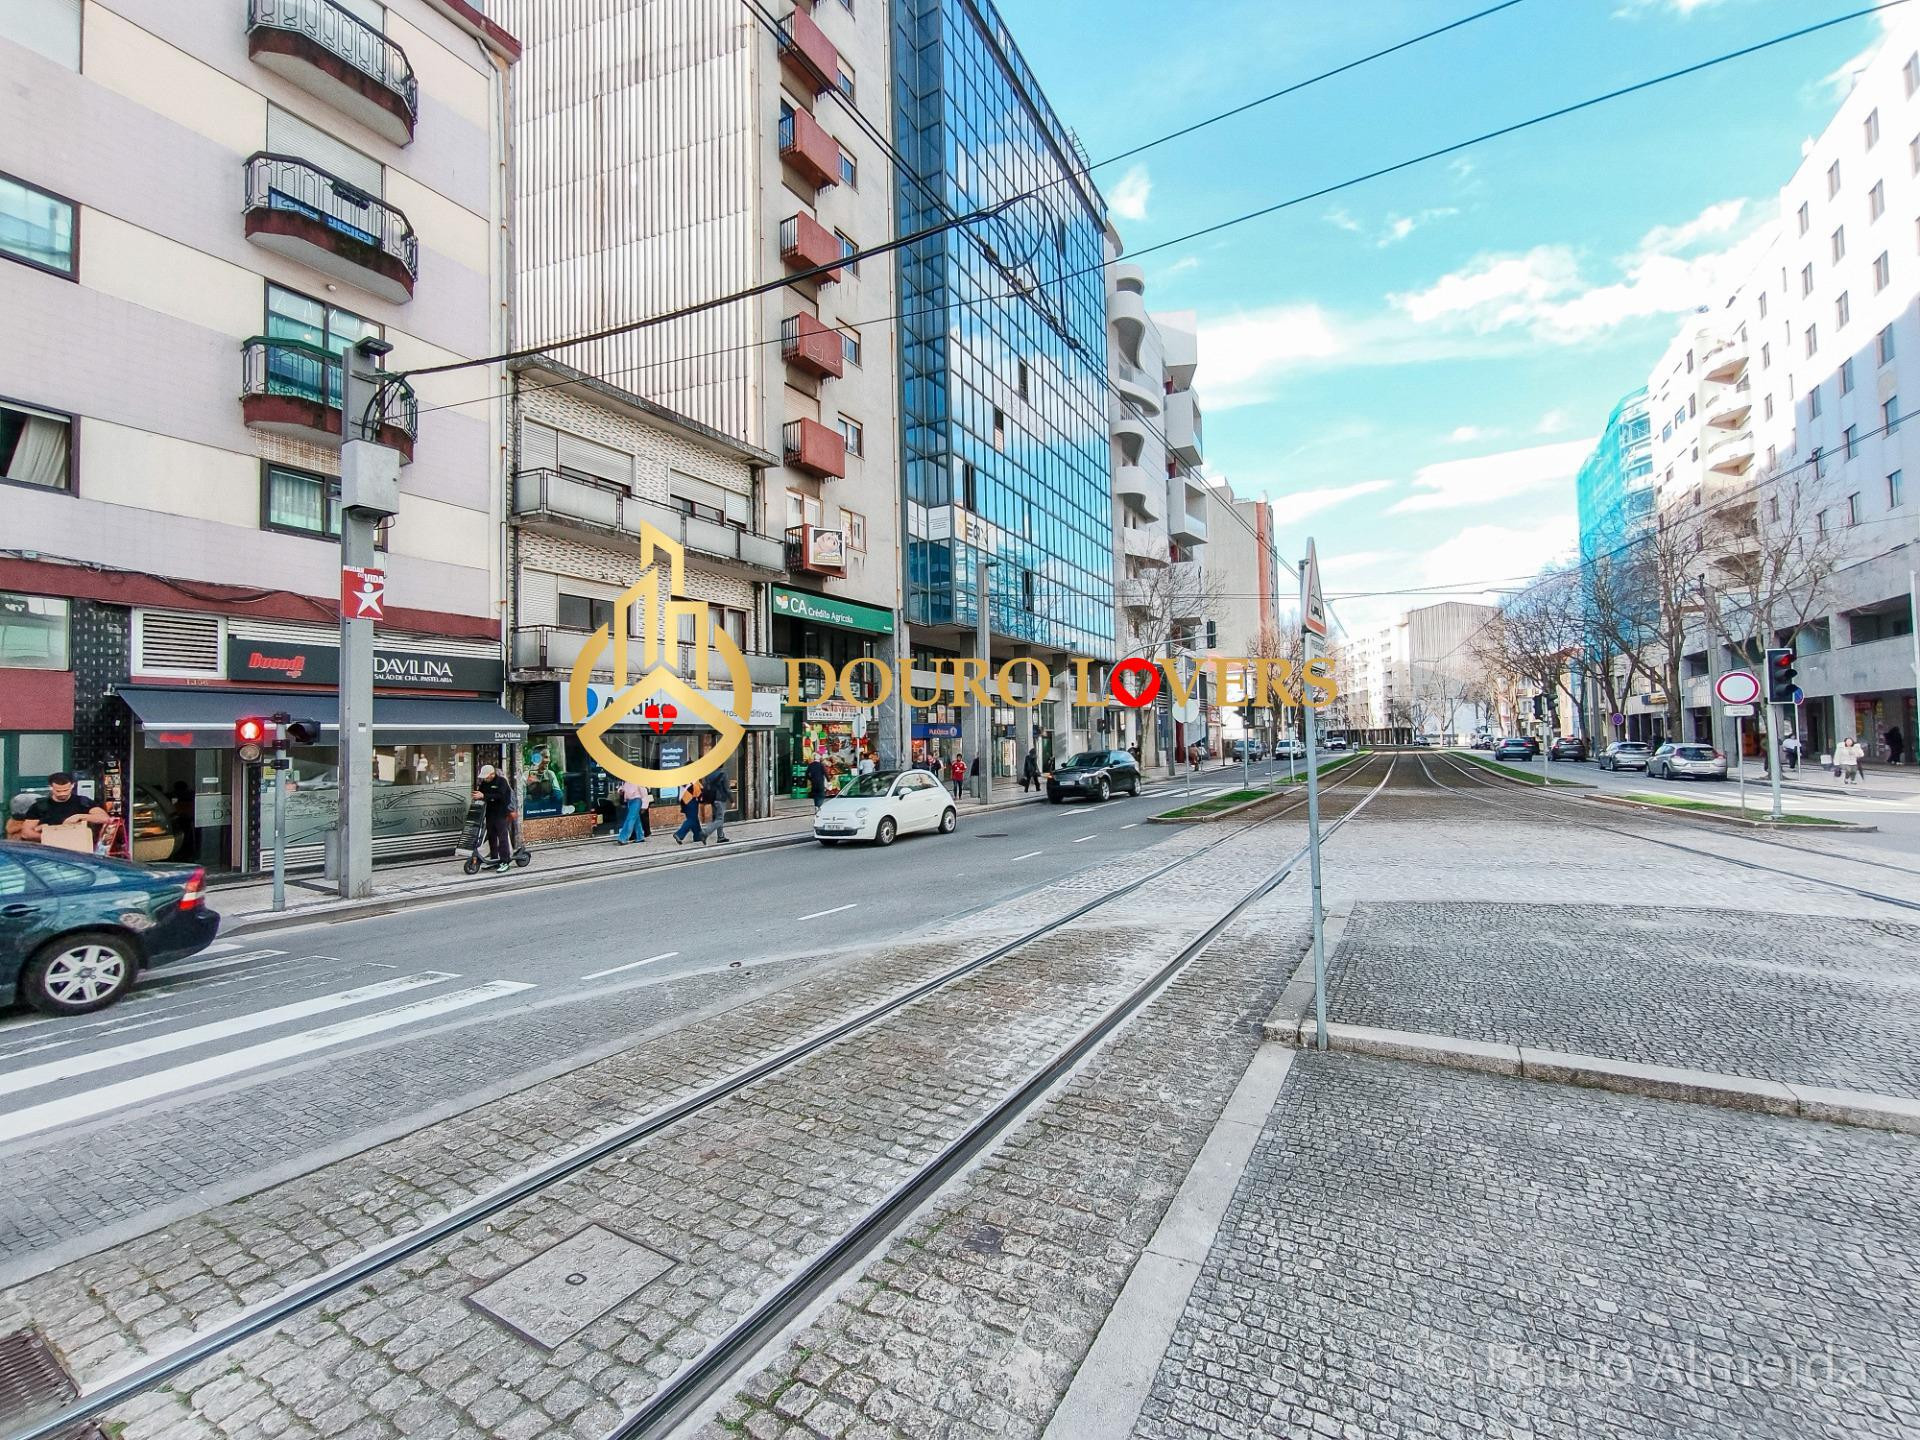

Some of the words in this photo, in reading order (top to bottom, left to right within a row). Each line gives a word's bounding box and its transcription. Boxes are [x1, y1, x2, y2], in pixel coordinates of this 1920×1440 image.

[364, 573, 384, 584] VIDA
[790, 598, 808, 615] CA
[808, 607, 830, 620] Crédito
[373, 657, 454, 677] DAVILINA
[420, 676, 453, 684] PASTELARIA
[494, 731, 521, 739] Davilina
[420, 815, 465, 829] DAVILIN
